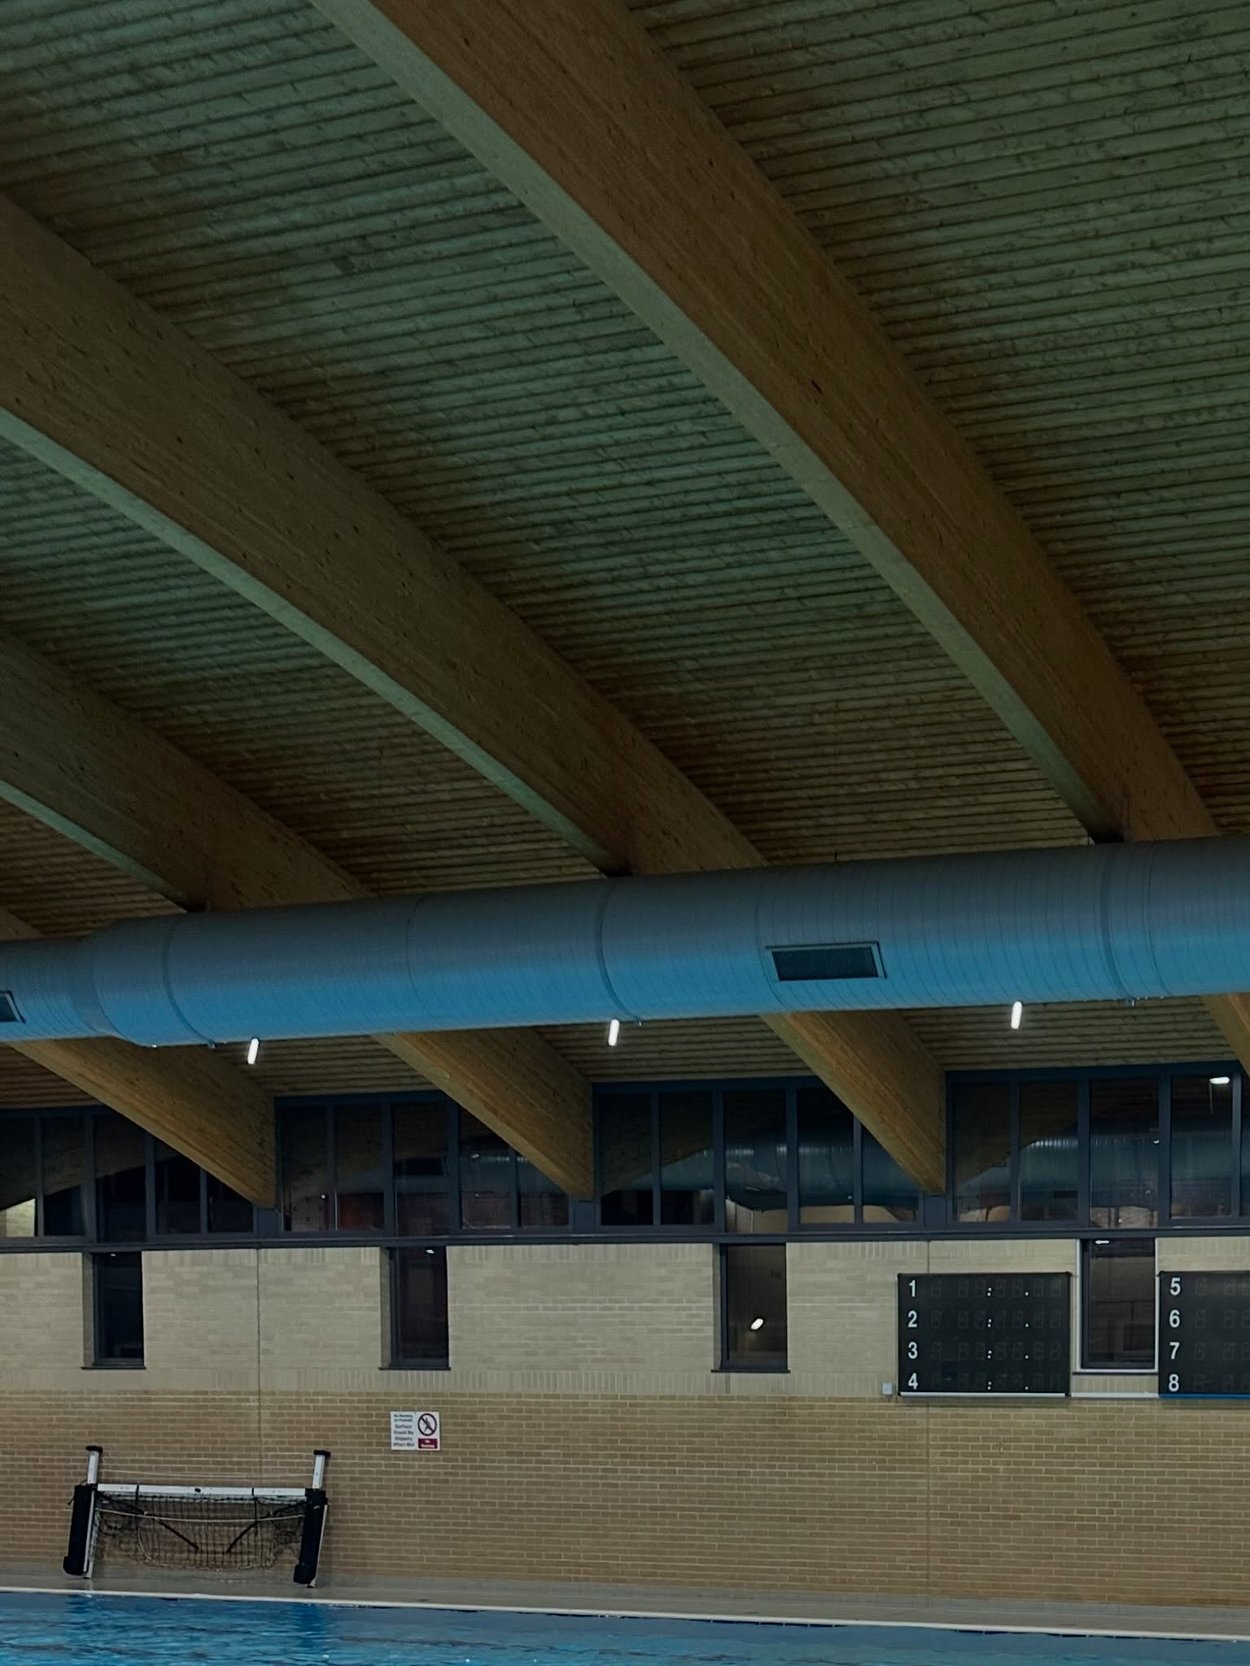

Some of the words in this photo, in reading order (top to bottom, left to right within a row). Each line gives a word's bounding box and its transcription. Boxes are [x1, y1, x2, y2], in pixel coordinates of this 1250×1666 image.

[908, 1279, 917, 1298] 1
[1169, 1277, 1181, 1296] 5
[907, 1310, 918, 1328] 2
[1169, 1309, 1181, 1328] 6
[907, 1341, 919, 1360] 3
[1169, 1341, 1180, 1360] 7
[907, 1372, 919, 1390] 4
[1168, 1373, 1180, 1392] 8
